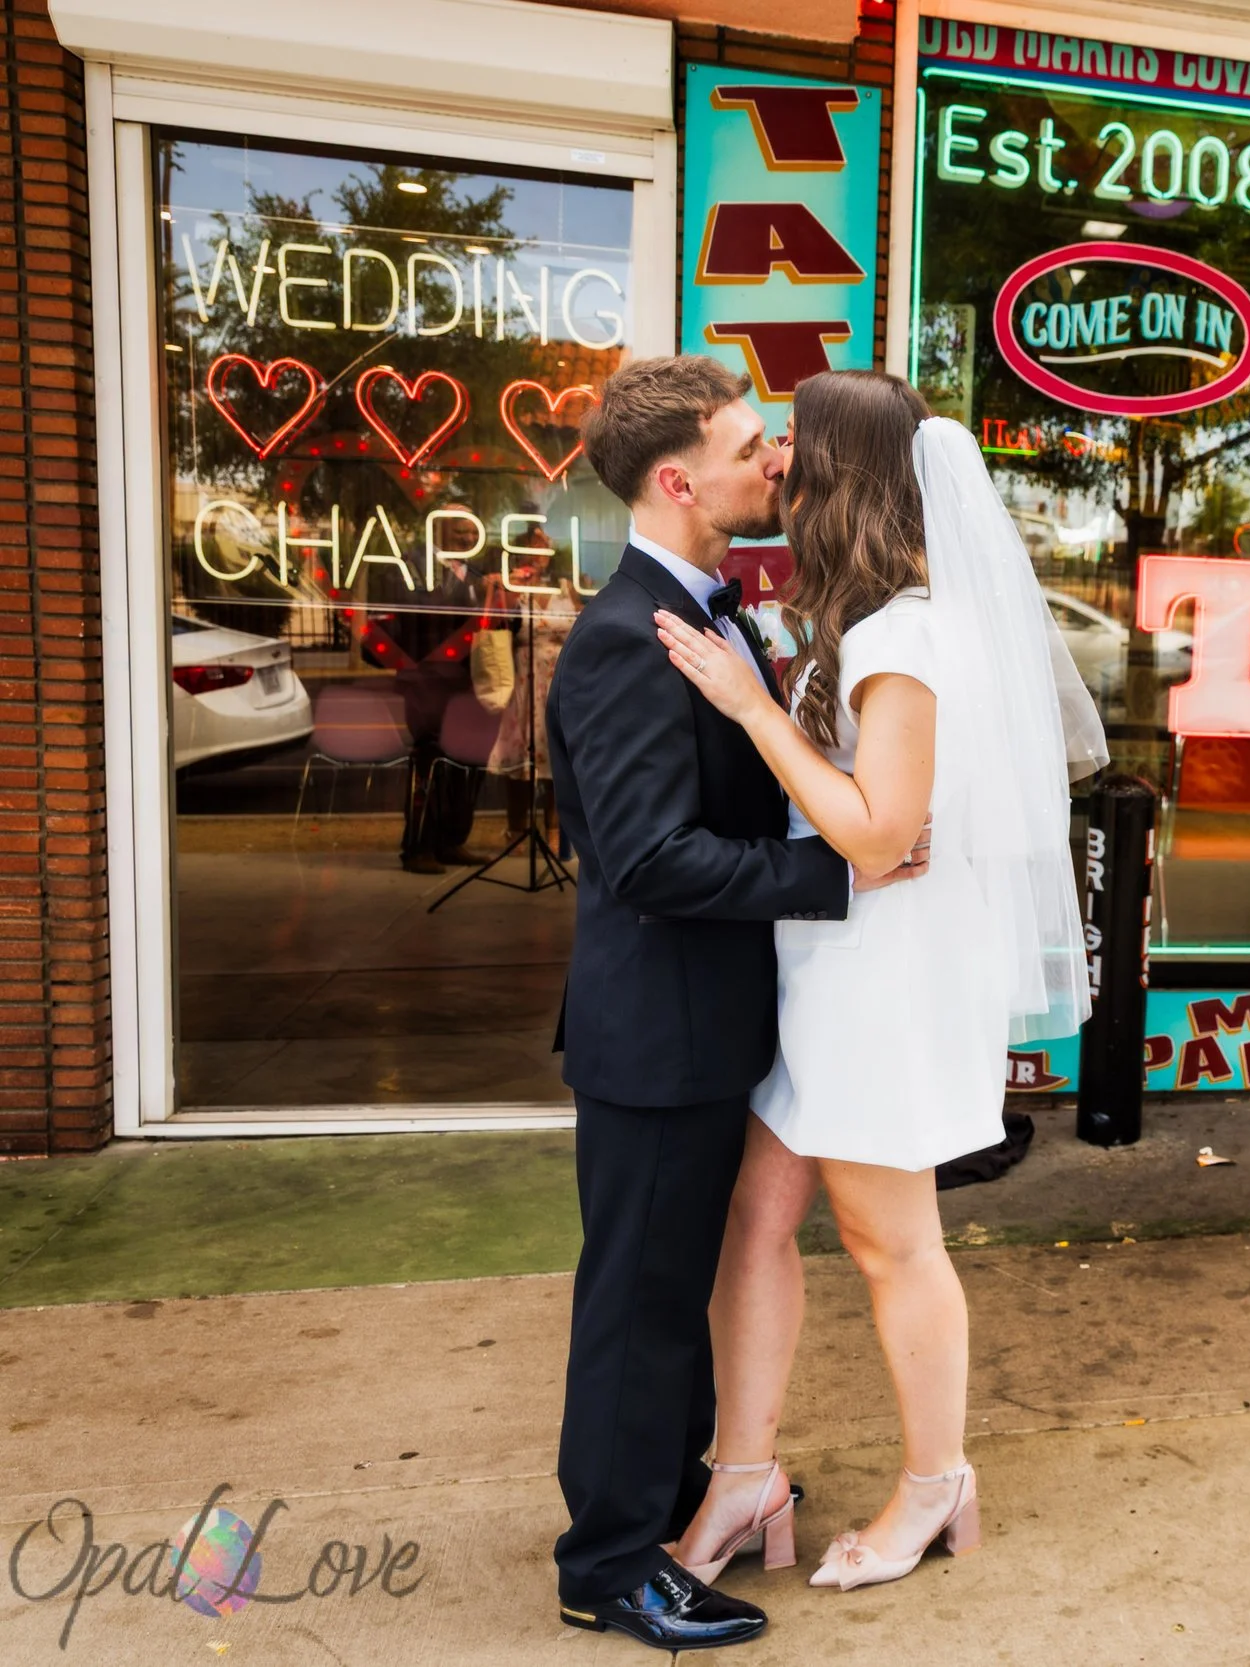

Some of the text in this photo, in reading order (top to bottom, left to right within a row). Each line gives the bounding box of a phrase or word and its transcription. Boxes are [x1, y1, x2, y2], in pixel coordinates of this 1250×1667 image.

[938, 105, 1079, 195] Est.
[182, 233, 624, 350] WEDDING
[1021, 292, 1235, 353] COME ON IN
[194, 500, 600, 596] CHAPEL
